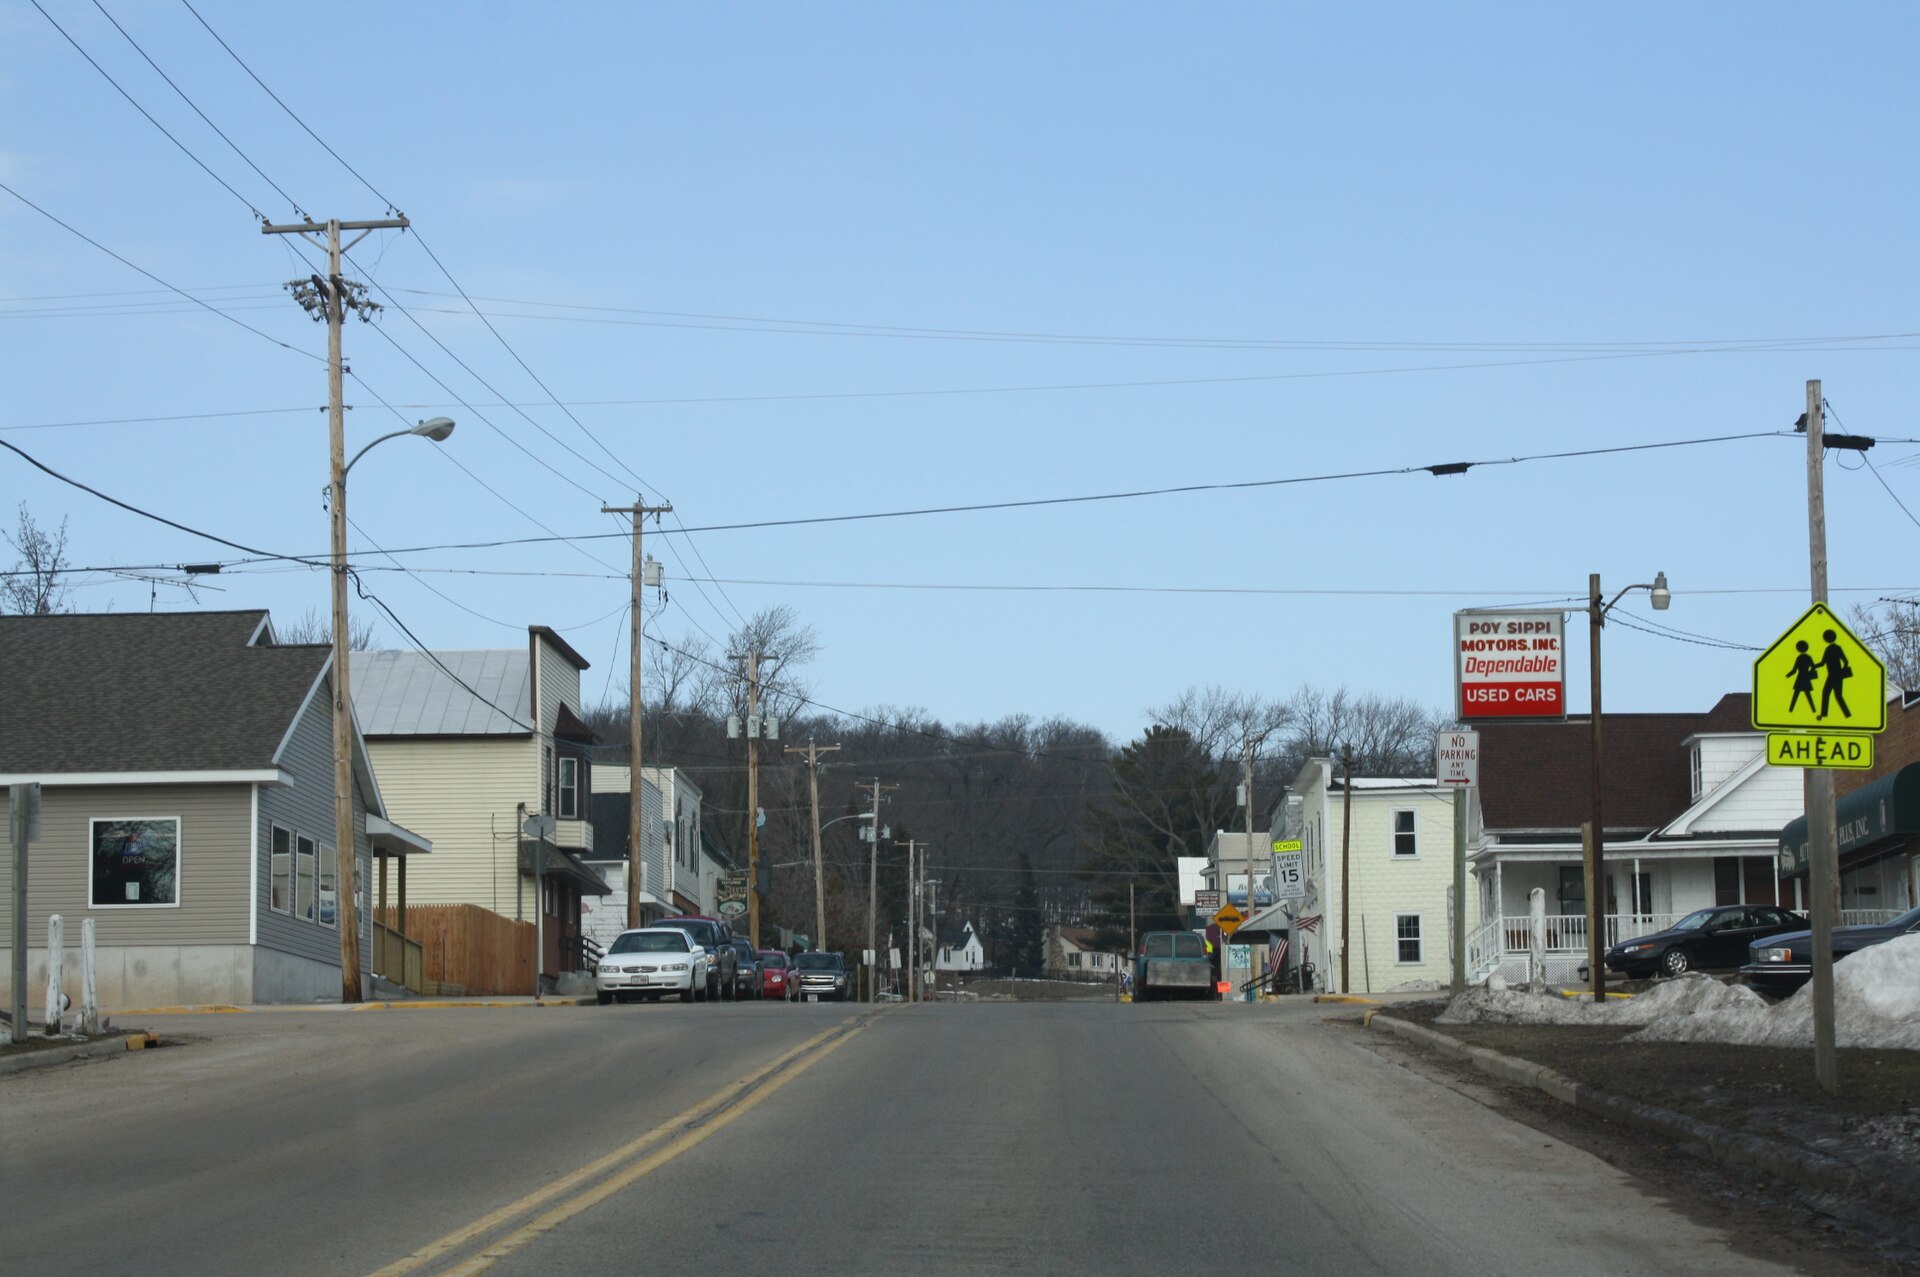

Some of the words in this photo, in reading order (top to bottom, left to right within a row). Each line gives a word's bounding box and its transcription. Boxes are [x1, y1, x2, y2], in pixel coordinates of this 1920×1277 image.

[1469, 622, 1501, 634] POY
[1507, 621, 1551, 634] SIPPI
[1465, 656, 1557, 677] Dependable
[1467, 688, 1510, 702] USED
[1514, 688, 1556, 701] CARS
[1451, 736, 1466, 748] NO
[1440, 749, 1476, 760] PARKING
[1779, 740, 1861, 761] AHEAD
[1275, 842, 1300, 851] SCHOOL
[122, 856, 146, 865] OPEN
[1276, 854, 1300, 862] SPEED
[1281, 868, 1299, 883] 15
